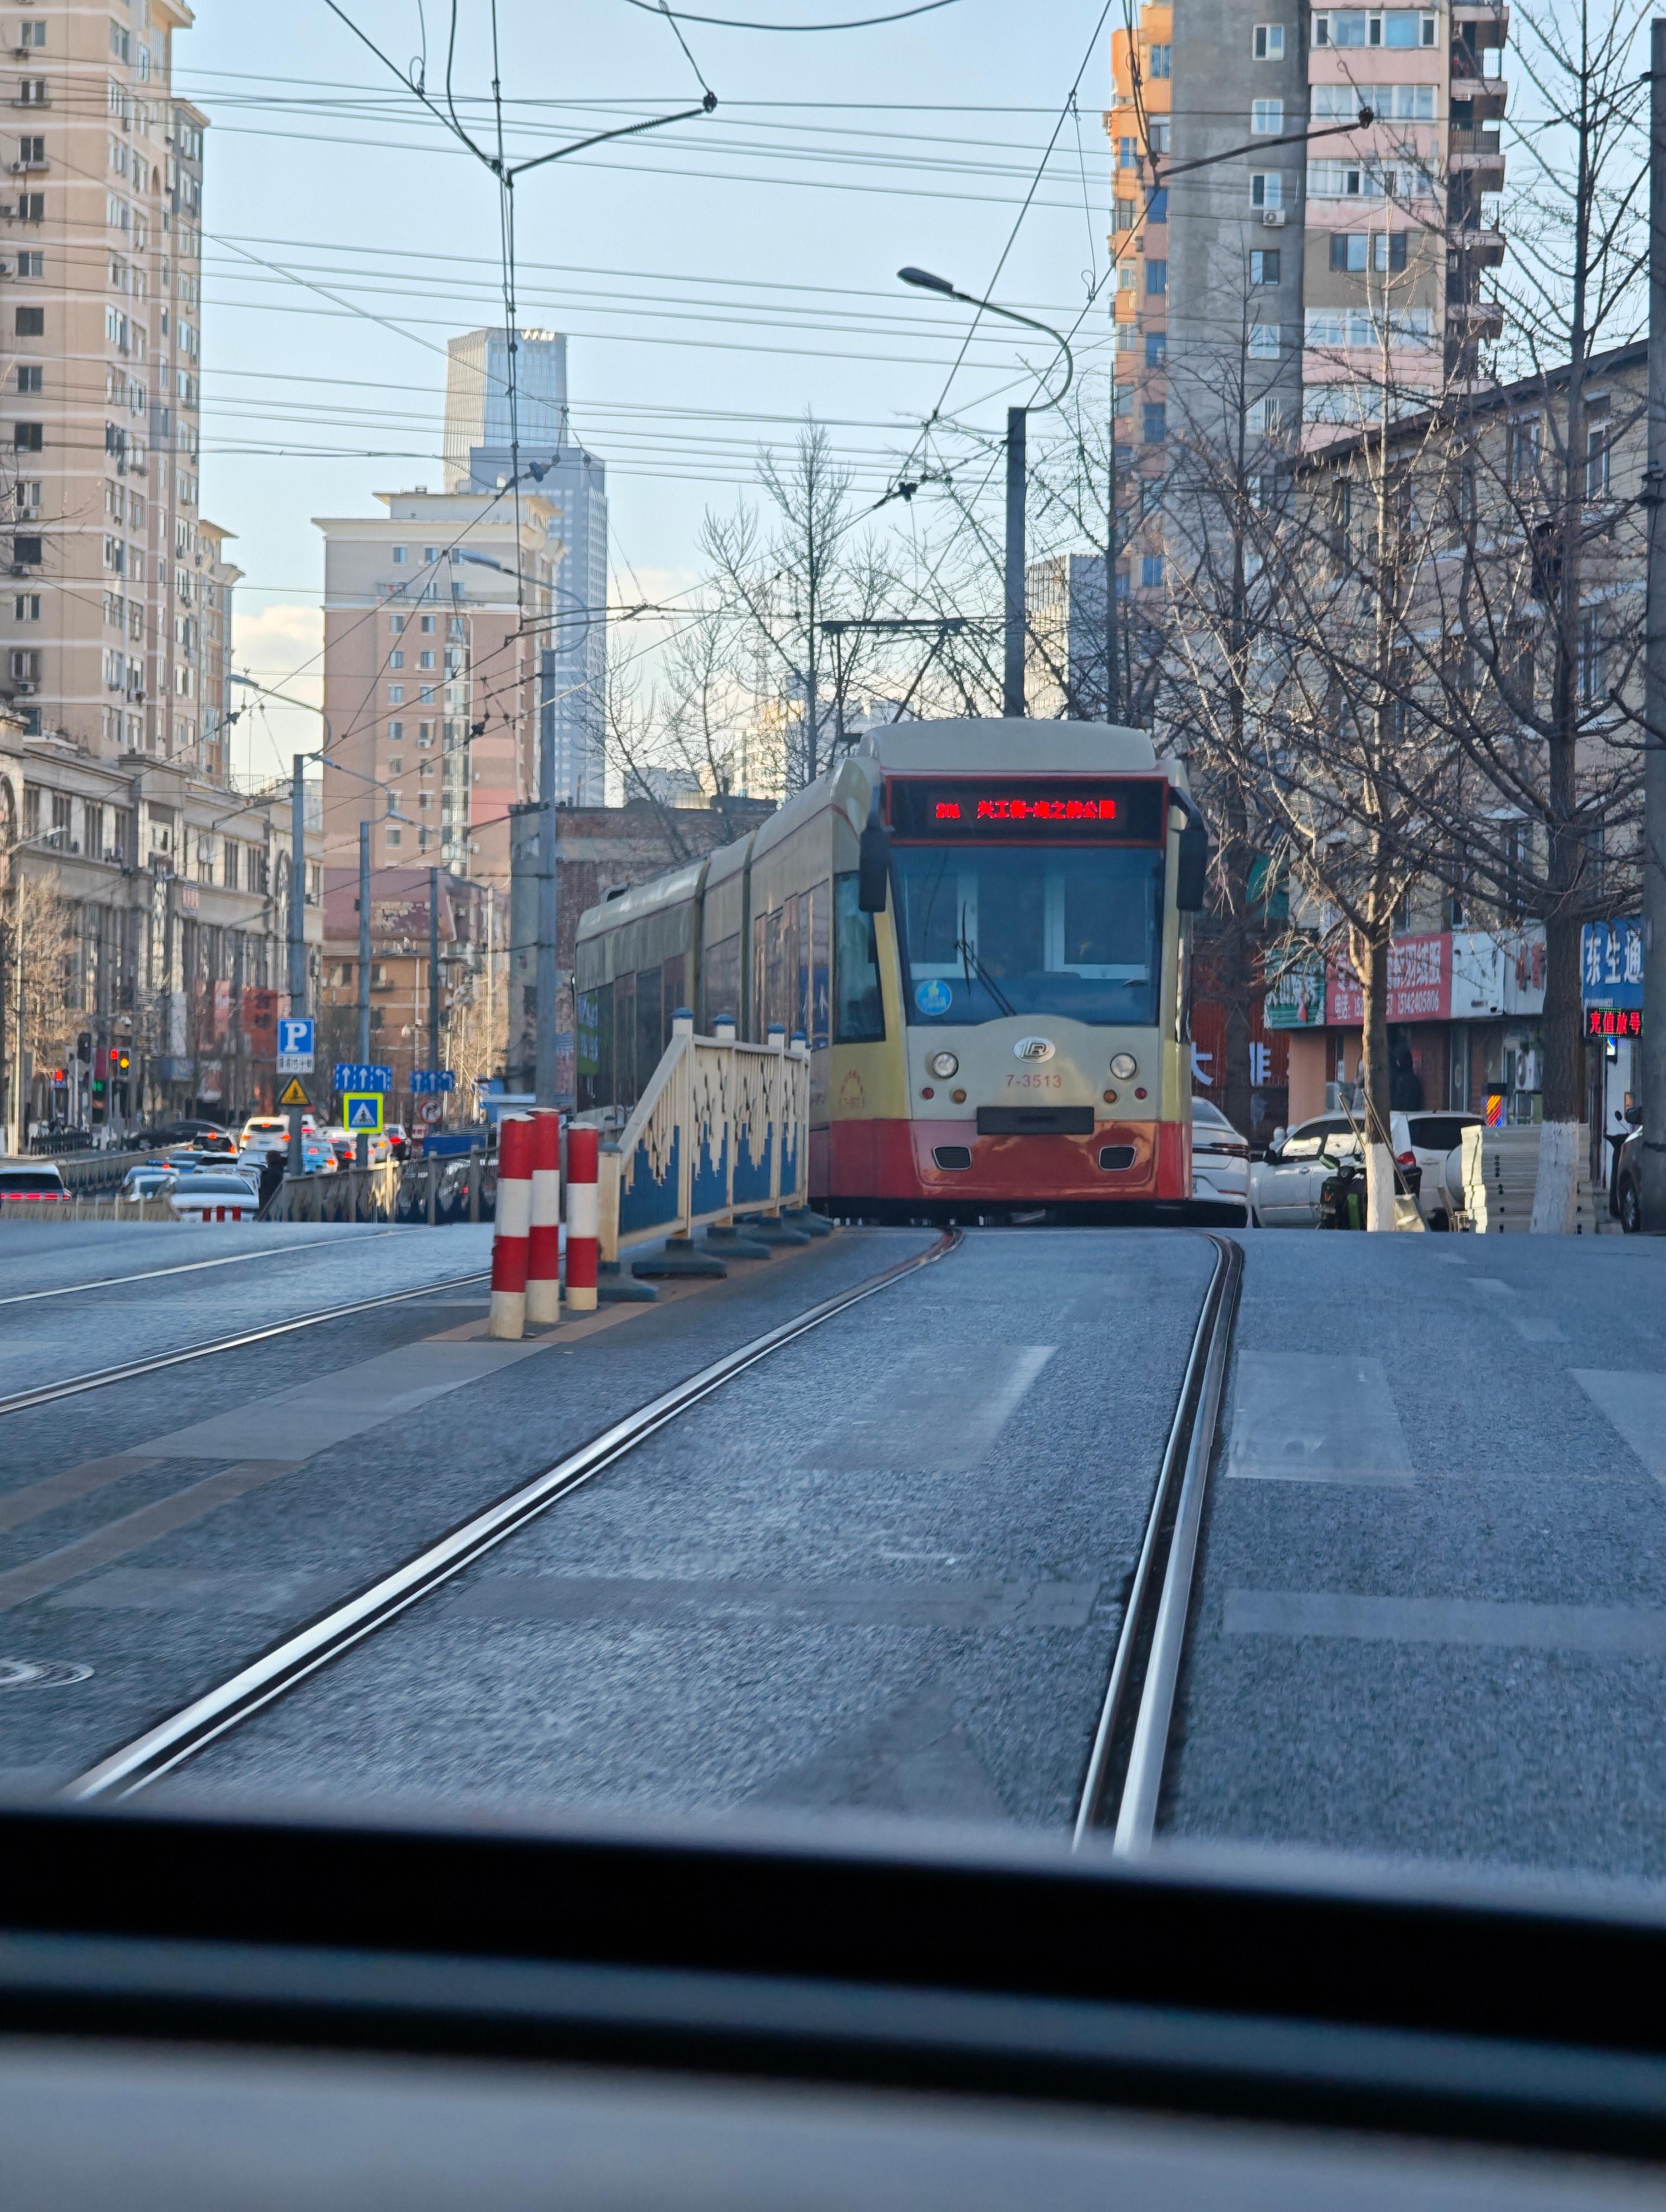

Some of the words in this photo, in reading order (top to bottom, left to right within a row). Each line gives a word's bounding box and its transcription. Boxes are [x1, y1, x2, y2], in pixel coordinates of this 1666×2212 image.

[935, 803, 960, 818] 201
[285, 1023, 307, 1052] P
[1006, 1074, 1061, 1088] 7-3513
